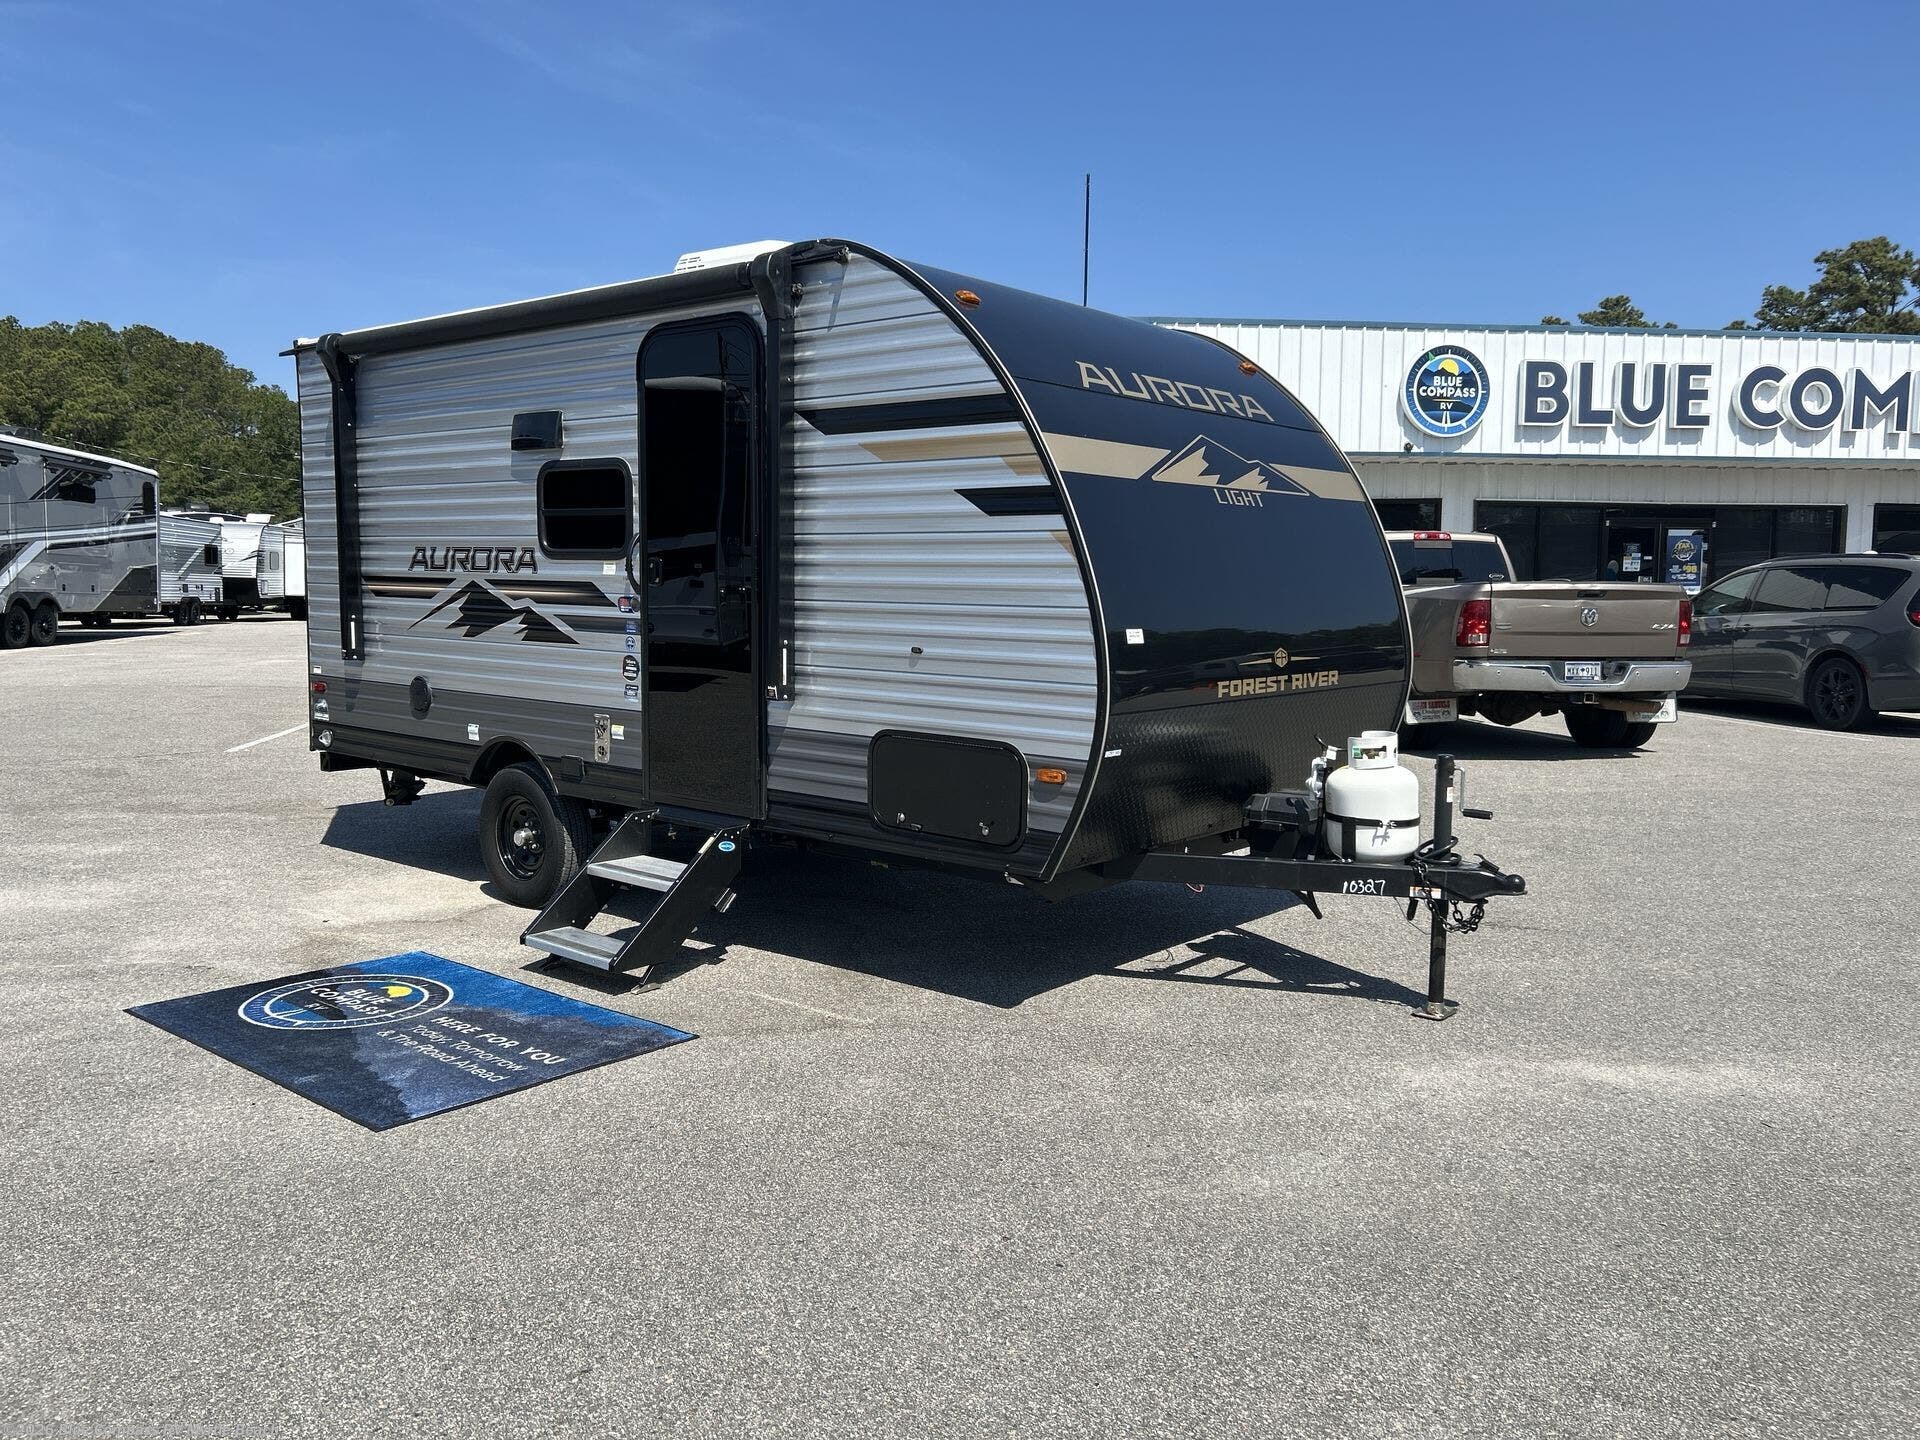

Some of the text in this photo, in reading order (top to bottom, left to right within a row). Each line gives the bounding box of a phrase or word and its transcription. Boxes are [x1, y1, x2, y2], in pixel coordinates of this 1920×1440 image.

[1075, 360, 1275, 422] AURORA
[1419, 386, 1476, 398] COMPASS
[1433, 376, 1463, 387] BLUE
[1440, 402, 1453, 410] RV
[1519, 359, 1920, 434] BLUE COM
[1214, 488, 1264, 508] LIGHT
[408, 546, 539, 575] AURORA
[1217, 670, 1339, 698] FOREST RIVER
[1342, 879, 1386, 896] 10327
[310, 987, 386, 1015] COMPASS
[345, 988, 392, 1006] BLUE
[430, 1016, 568, 1065] HERE FOR YOU
[388, 1033, 419, 1047] The
[417, 1044, 462, 1063] Road
[450, 1059, 511, 1083] Ahead
[451, 1039, 528, 1072] Tomorrow
